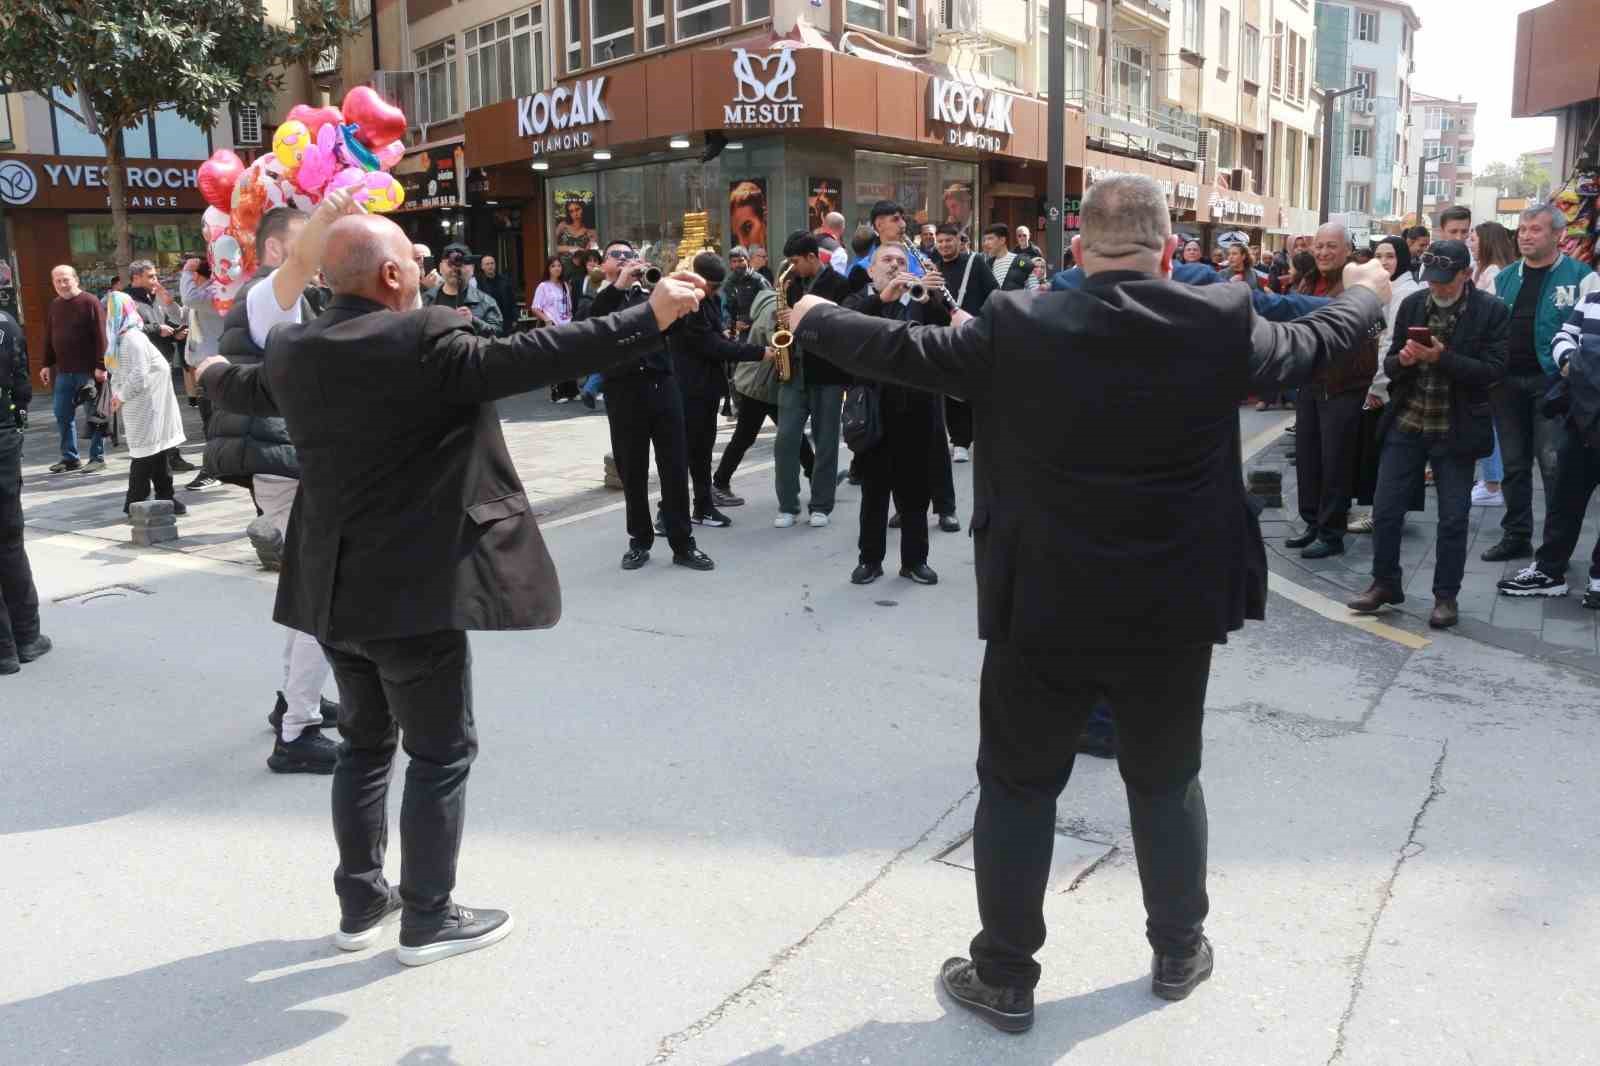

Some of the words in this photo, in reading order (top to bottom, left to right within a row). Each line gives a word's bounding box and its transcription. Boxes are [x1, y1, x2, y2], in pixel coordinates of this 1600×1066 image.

[723, 103, 804, 124] MESUT
[533, 131, 592, 154] DIAMOND
[126, 167, 201, 189] ROCH
[106, 196, 177, 207] FANCE
